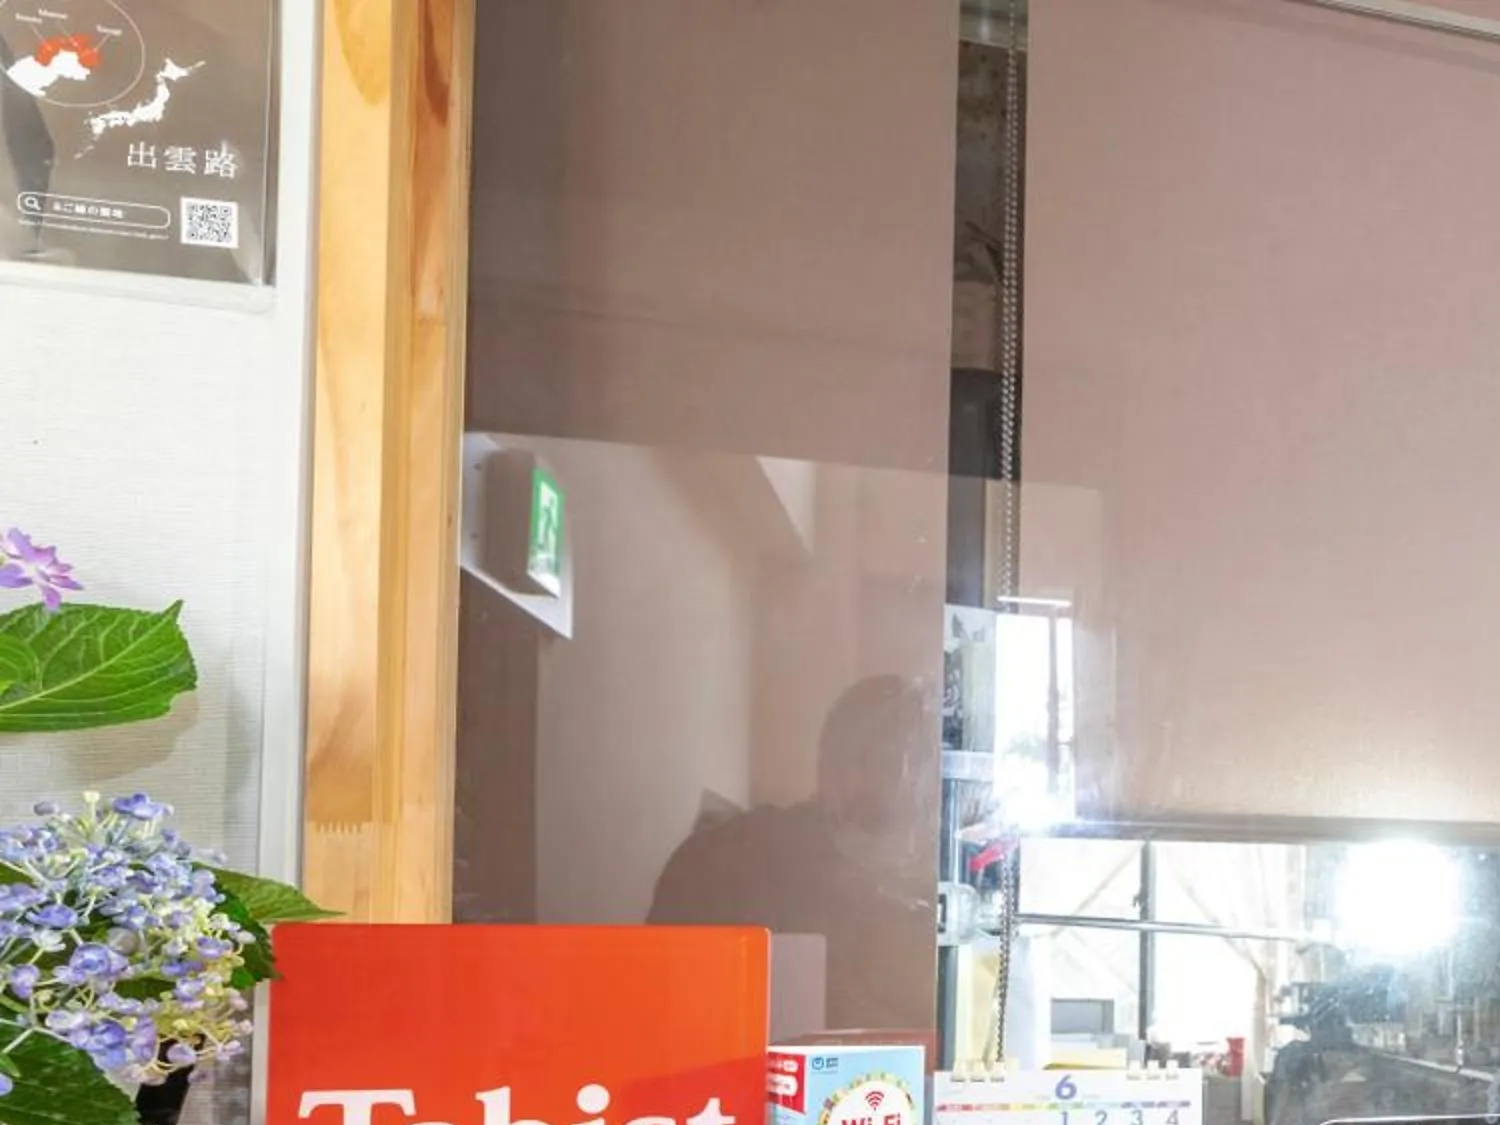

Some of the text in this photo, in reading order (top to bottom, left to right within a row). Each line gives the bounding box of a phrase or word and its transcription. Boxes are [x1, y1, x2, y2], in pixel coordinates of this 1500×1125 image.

[127, 141, 237, 178] 出雲路
[1054, 1074, 1077, 1100] 6
